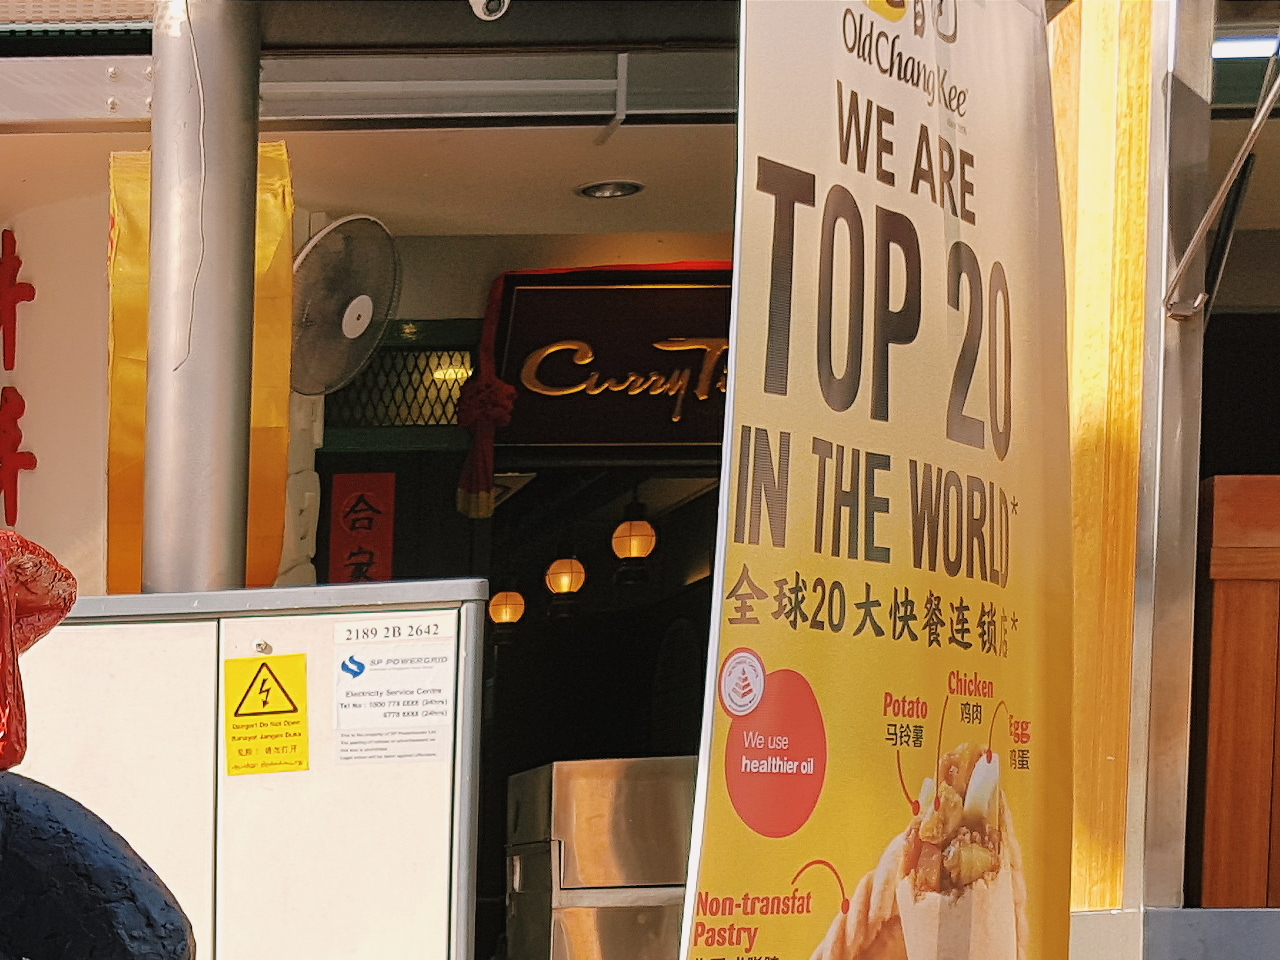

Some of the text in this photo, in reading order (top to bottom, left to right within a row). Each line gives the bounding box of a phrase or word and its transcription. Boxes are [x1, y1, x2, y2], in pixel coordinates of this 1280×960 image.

[837, 79, 976, 226] WE ARE
[757, 155, 1012, 461] TOP 20
[521, 340, 691, 422] Curry
[734, 425, 791, 547] IN
[812, 437, 891, 563] THE
[346, 624, 439, 641] 2189 2B 2642
[345, 687, 442, 698] Electricity Service Centre
[948, 669, 994, 699] Chicken
[883, 692, 928, 720] Potato
[961, 702, 982, 724] 鸡肉
[743, 731, 789, 750] We use
[885, 724, 924, 748] 马铃薯
[741, 754, 814, 775] healthier oil
[696, 888, 812, 917] Non-transfat
[693, 921, 758, 954] Pastry
